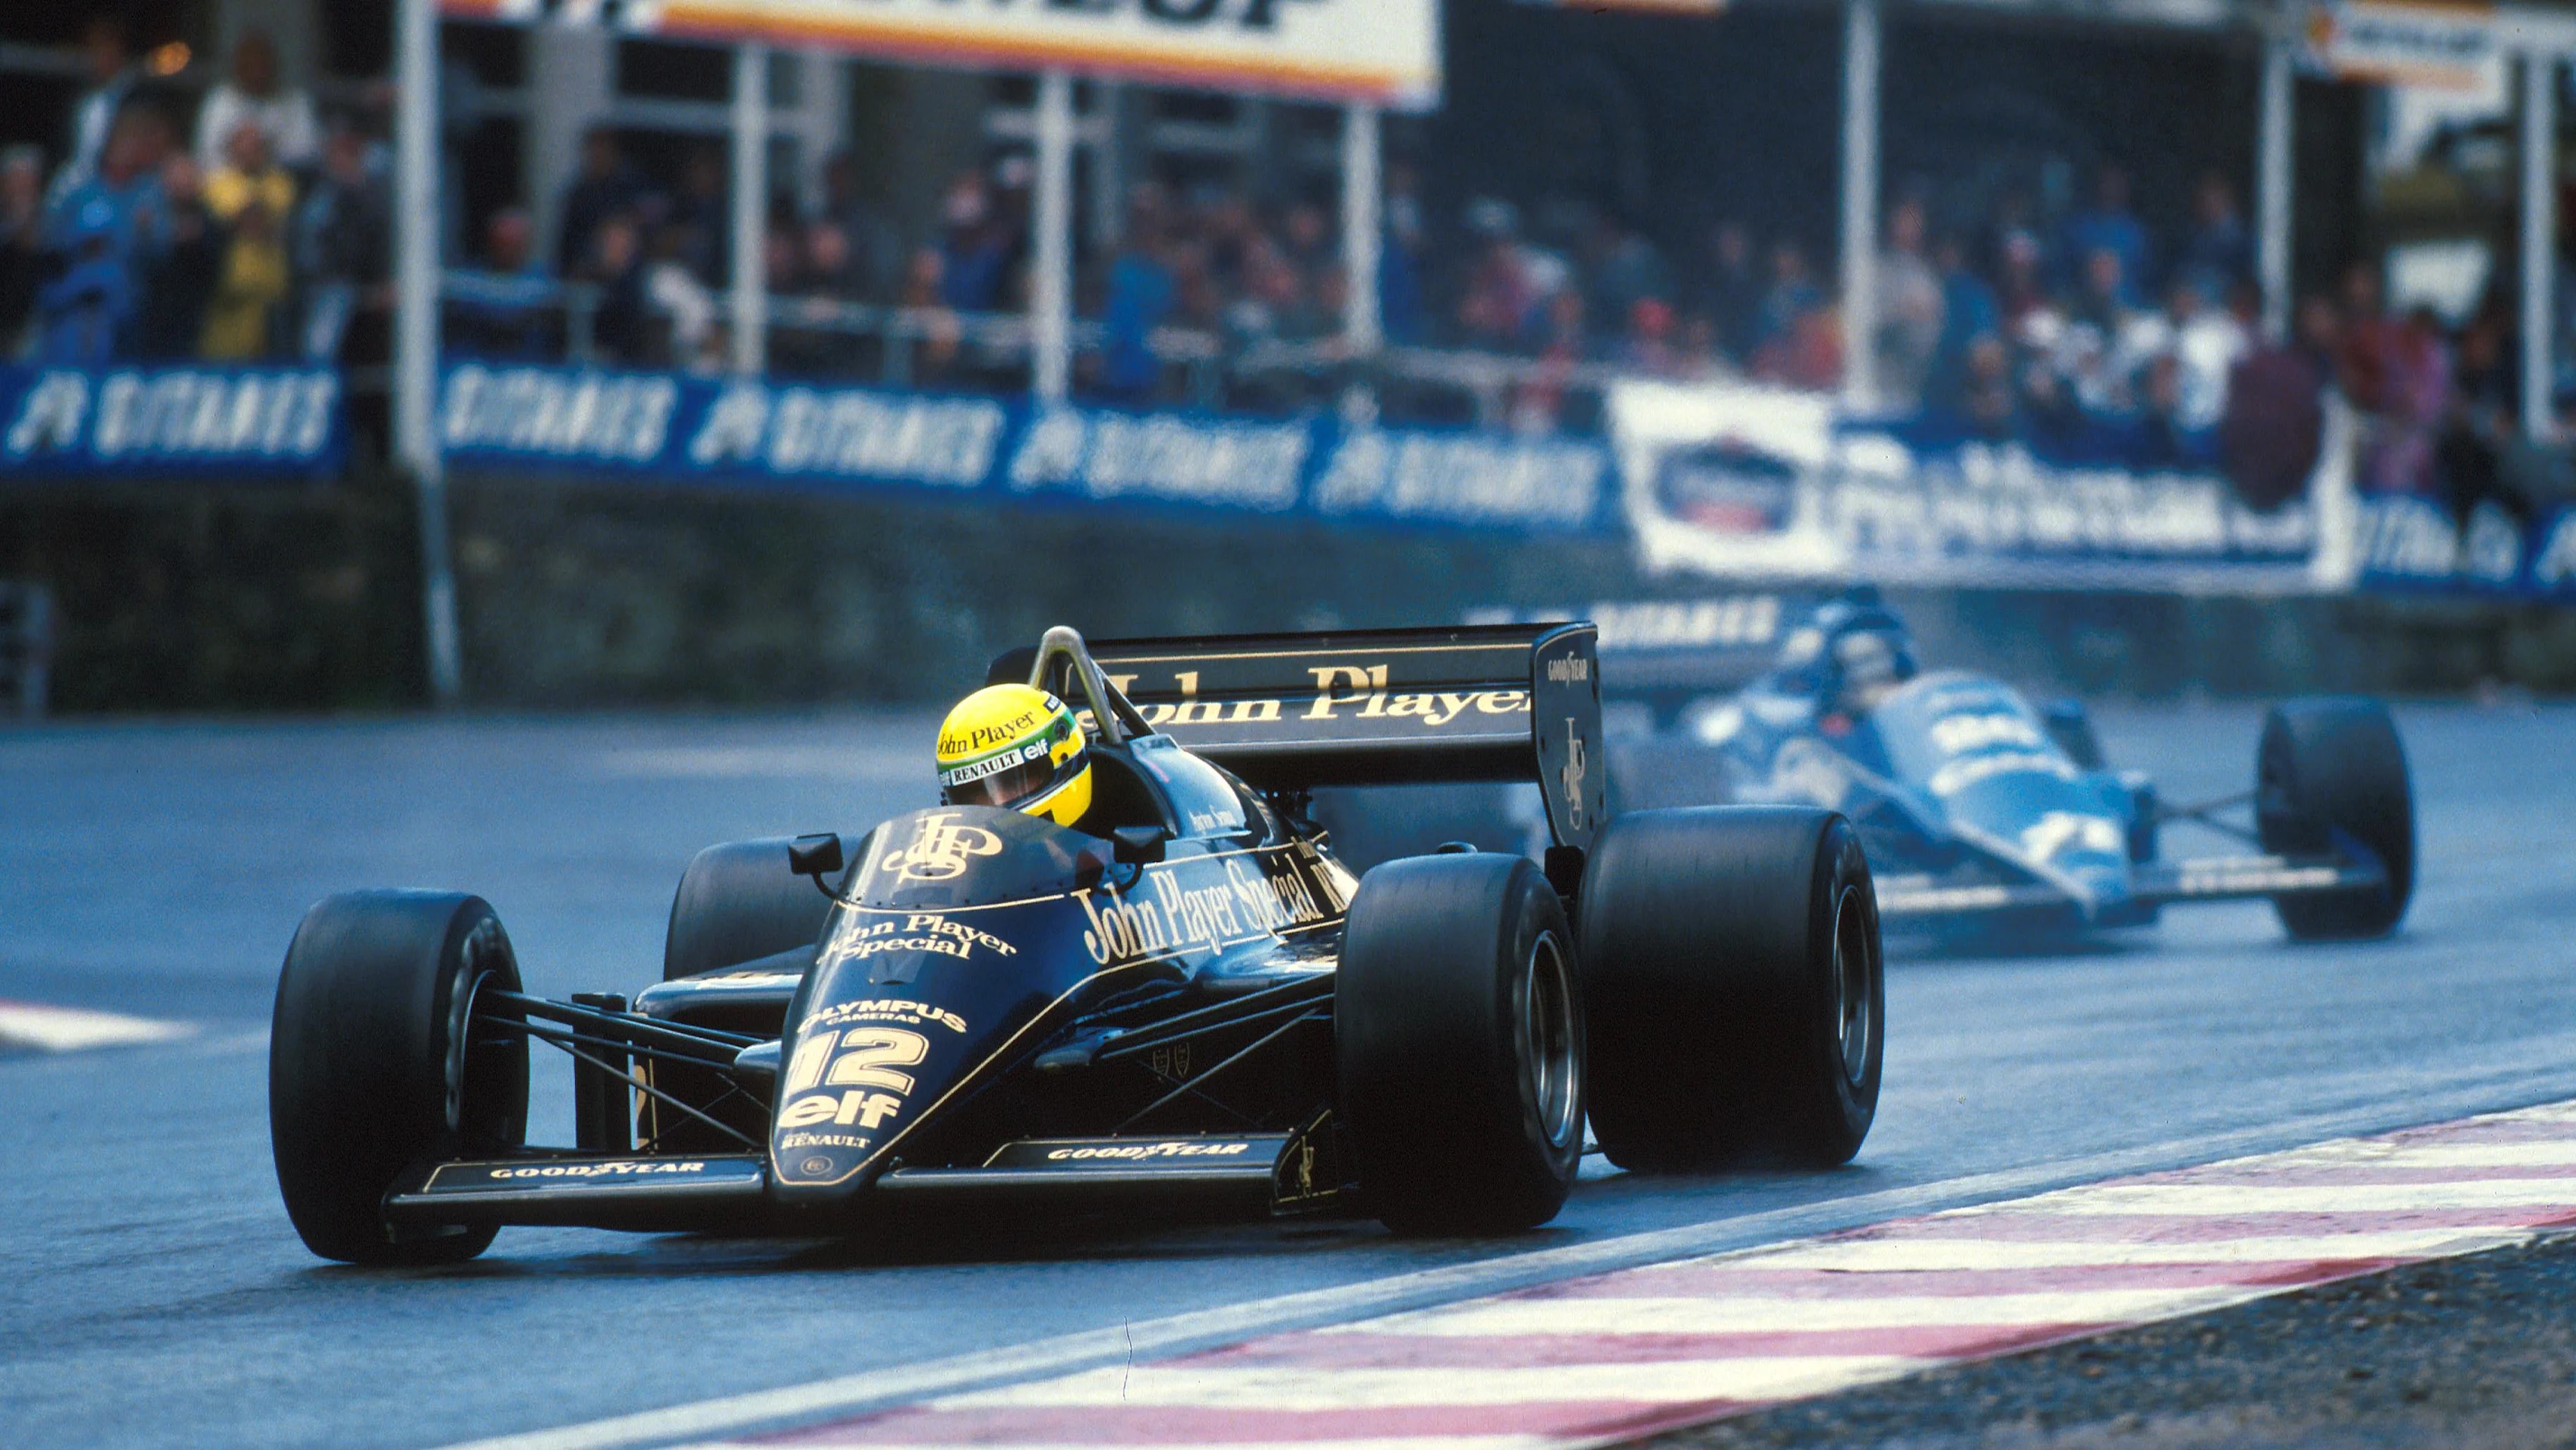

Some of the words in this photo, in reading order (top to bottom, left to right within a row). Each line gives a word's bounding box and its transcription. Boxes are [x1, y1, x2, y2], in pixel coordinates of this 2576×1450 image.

[1548, 651, 1588, 689] GOODYEAR
[971, 712, 1036, 750] Player
[953, 752, 1016, 782] RENAULT
[1024, 738, 1049, 760] elf
[1070, 881, 1167, 965] John
[1149, 868, 1243, 956] Player
[1226, 853, 1324, 944] Special
[841, 934, 970, 960] Special
[901, 915, 1018, 957] Player
[797, 1000, 968, 1033] OLYMPUS
[826, 1012, 921, 1026] CAMERAS
[787, 1027, 930, 1097] 12
[778, 1091, 901, 1129] elf
[781, 1133, 871, 1150] RENAULT
[1047, 1141, 1249, 1161] GOODYEAR
[490, 1161, 705, 1179] GOODYEAR
